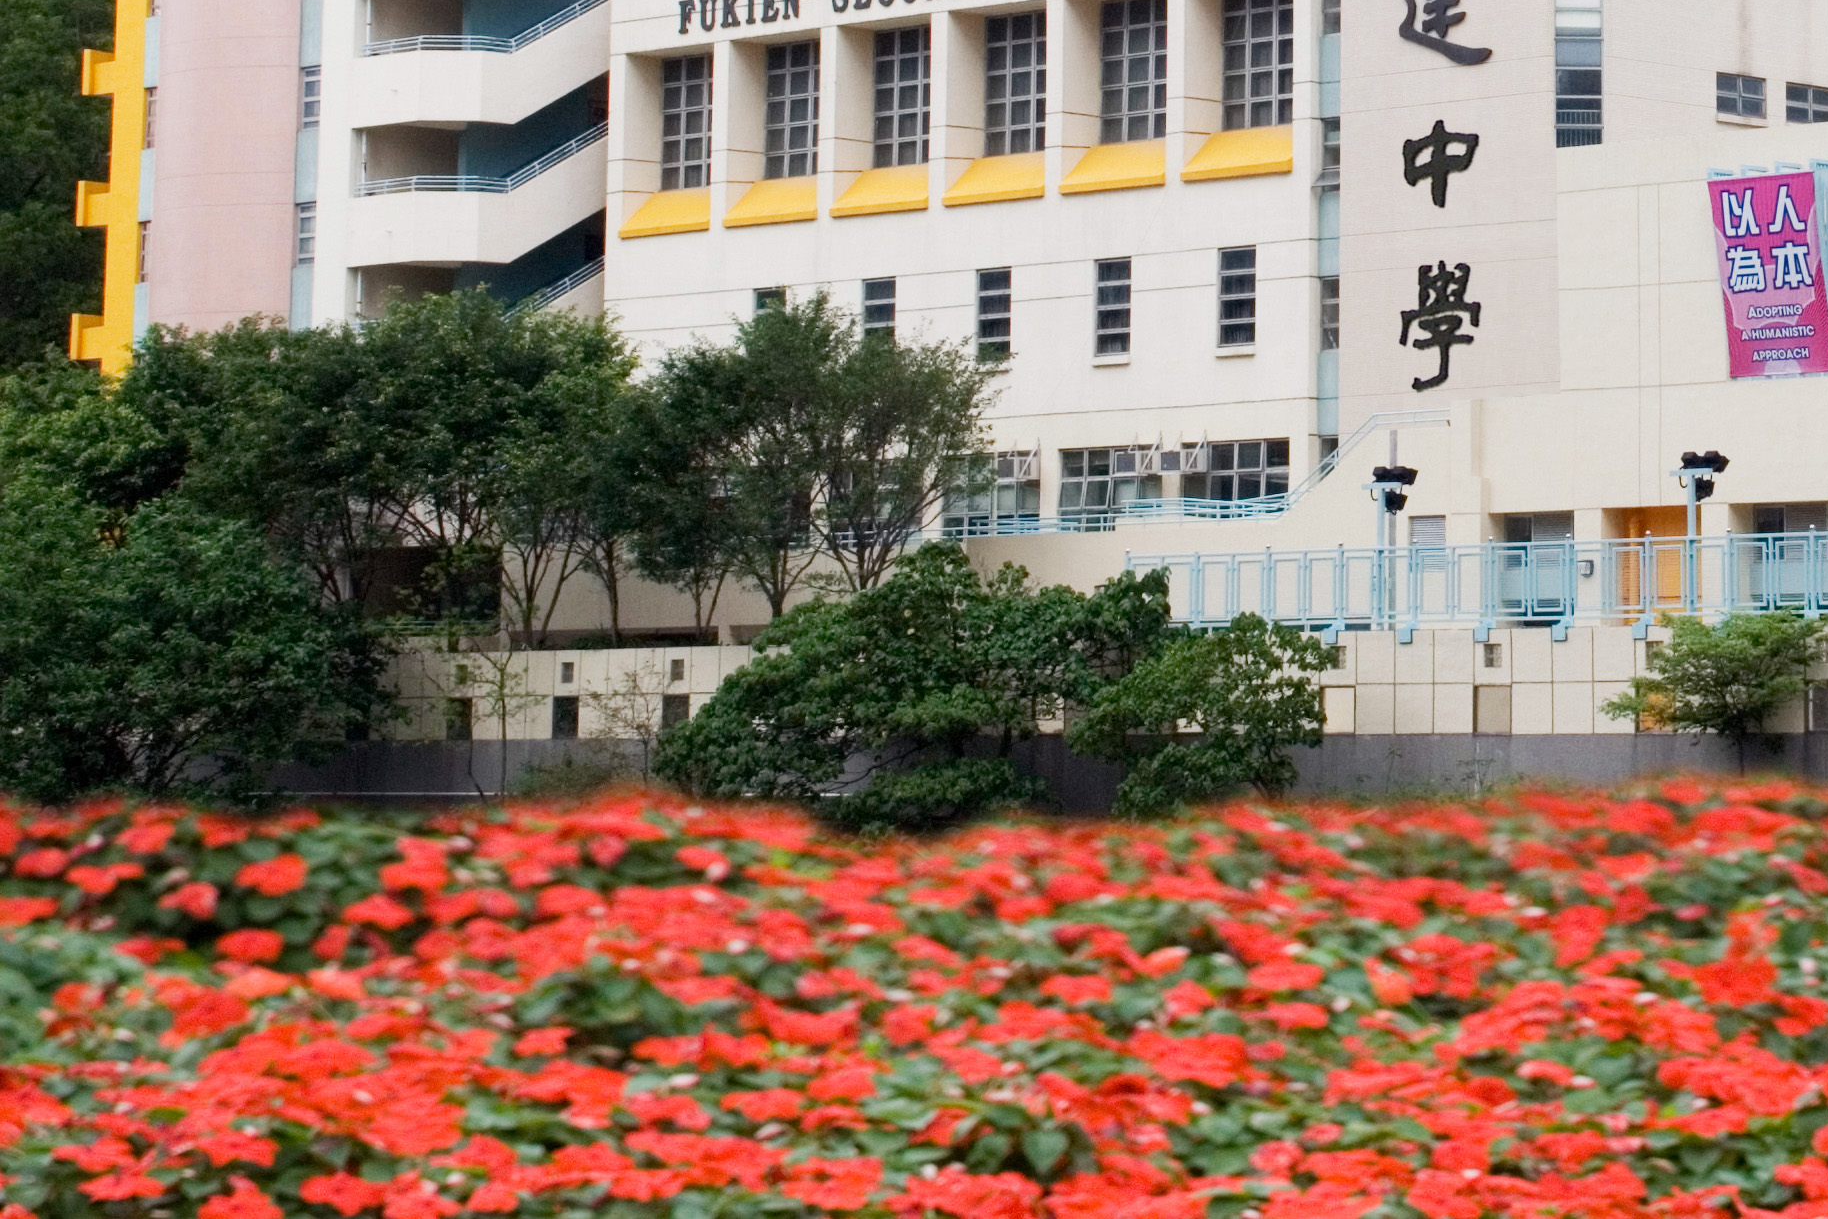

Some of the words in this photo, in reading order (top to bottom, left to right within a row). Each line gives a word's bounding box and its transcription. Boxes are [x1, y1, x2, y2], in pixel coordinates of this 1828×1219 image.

[1721, 185, 1806, 236] 以人
[1726, 242, 1814, 293] 為本
[1747, 305, 1803, 319] ADOPTING
[1741, 330, 1750, 341] A
[1751, 325, 1815, 340] HUMANISTIC
[1752, 347, 1810, 362] APPROACH
